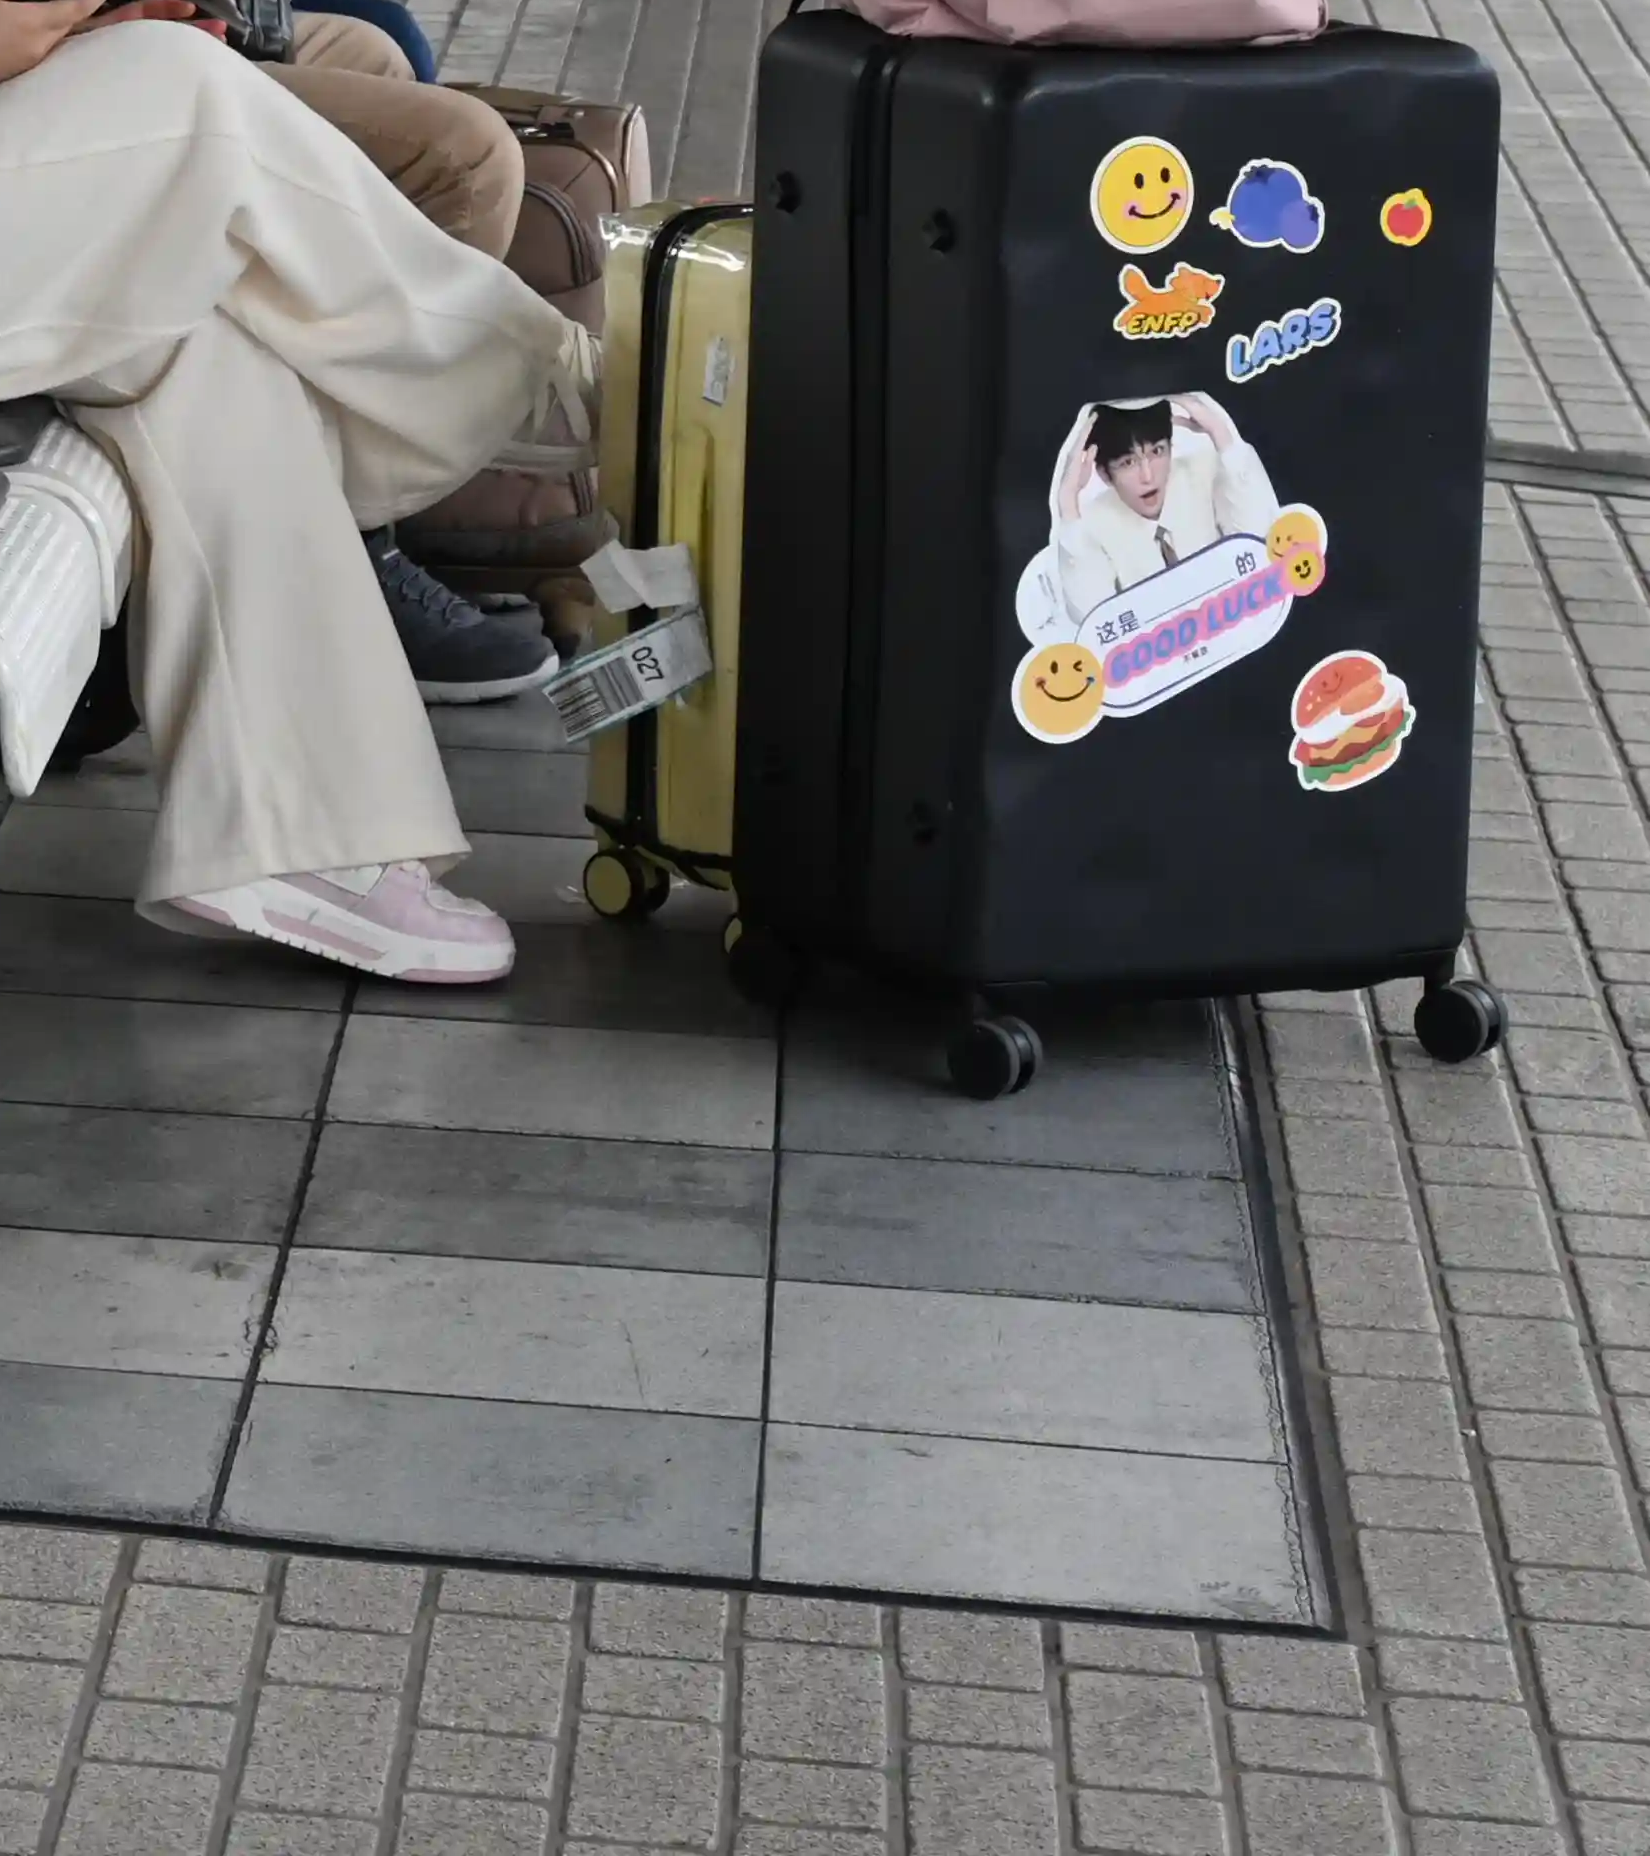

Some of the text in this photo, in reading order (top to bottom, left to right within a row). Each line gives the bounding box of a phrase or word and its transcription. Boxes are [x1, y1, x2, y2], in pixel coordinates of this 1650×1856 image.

[1126, 310, 1200, 336] ENFP
[1230, 302, 1339, 379] LARS
[1096, 551, 1257, 645] 这是 的
[1110, 568, 1287, 682] GOOD LUCK
[632, 646, 665, 682] 027
